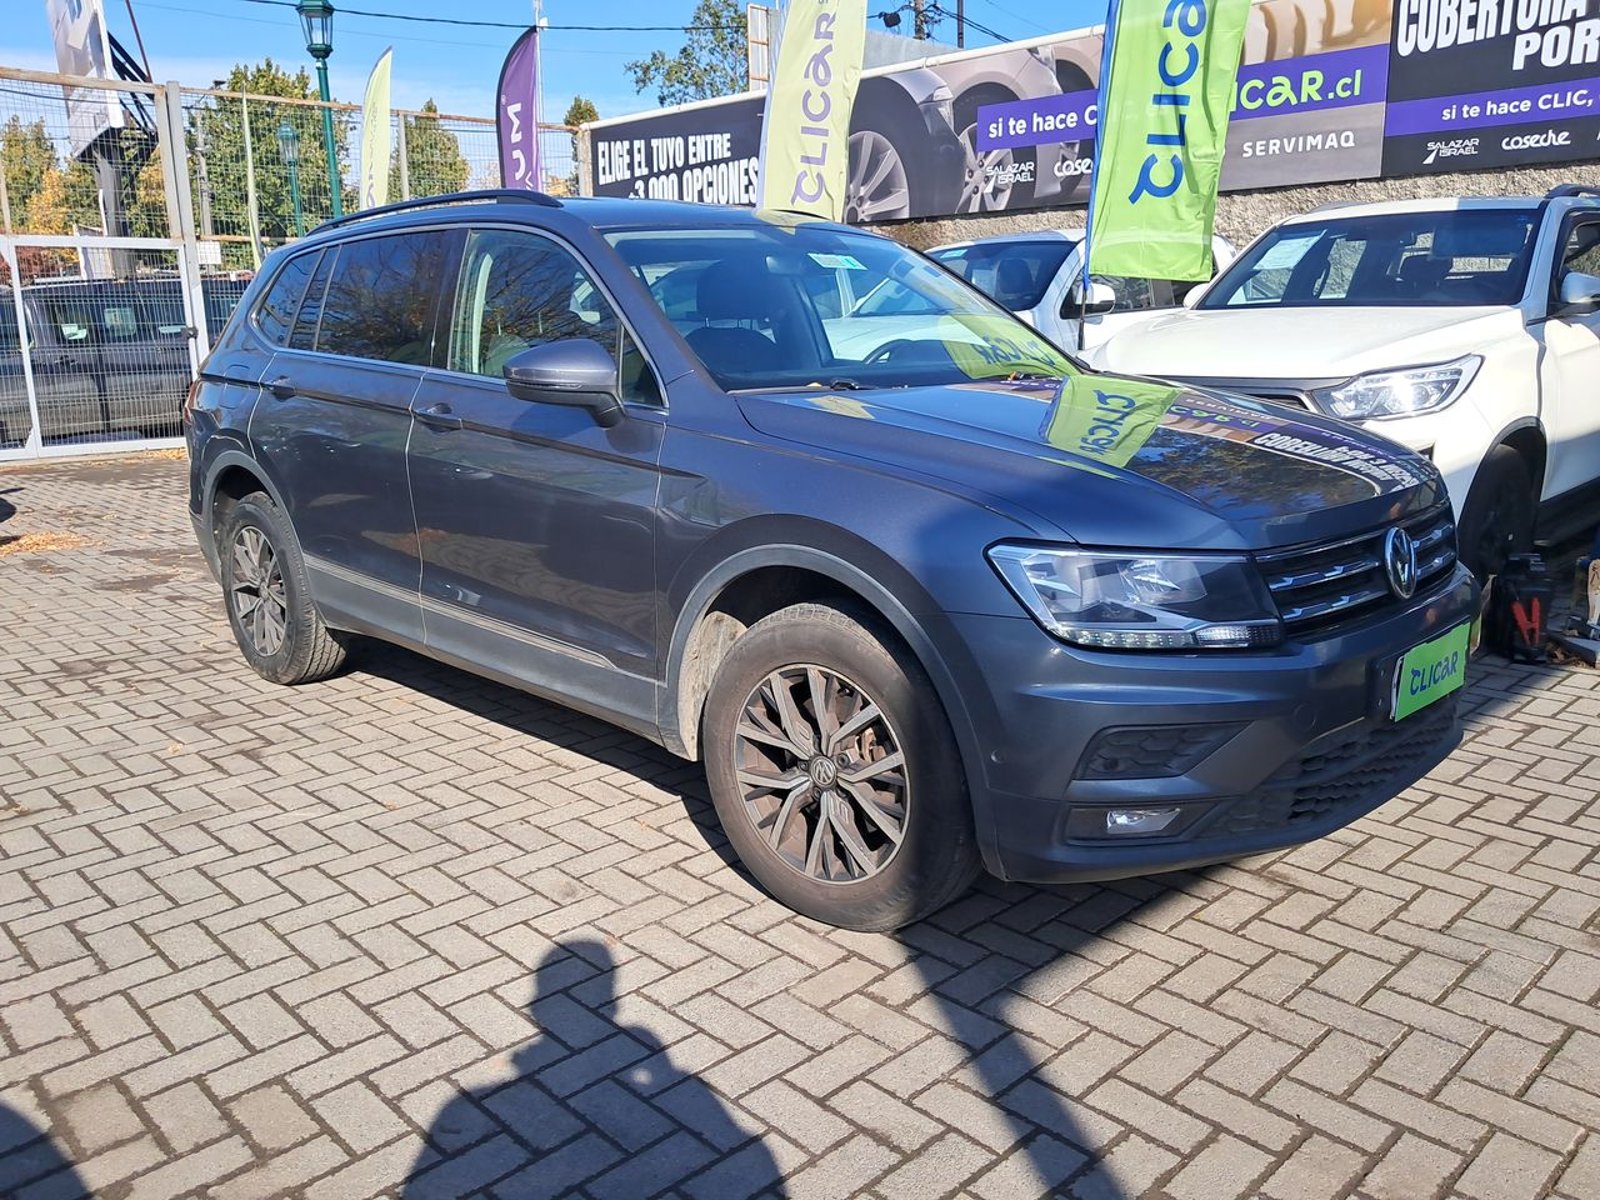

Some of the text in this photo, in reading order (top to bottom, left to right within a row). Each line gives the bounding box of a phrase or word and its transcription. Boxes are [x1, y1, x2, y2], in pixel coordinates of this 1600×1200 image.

[1512, 18, 1600, 71] POR
[1441, 89, 1594, 121] si te hace CLIC,
[988, 117, 1004, 139] si
[1008, 116, 1027, 136] te
[1032, 111, 1079, 133] hace
[1242, 130, 1356, 158] SERVIMAQ
[1426, 138, 1480, 151] SALAZAR
[1501, 129, 1571, 151] coseche
[597, 133, 732, 186] ELIGE EL TUYO ENTRE
[985, 161, 1036, 177] SALAZAR
[682, 156, 760, 206] OPCIONES
